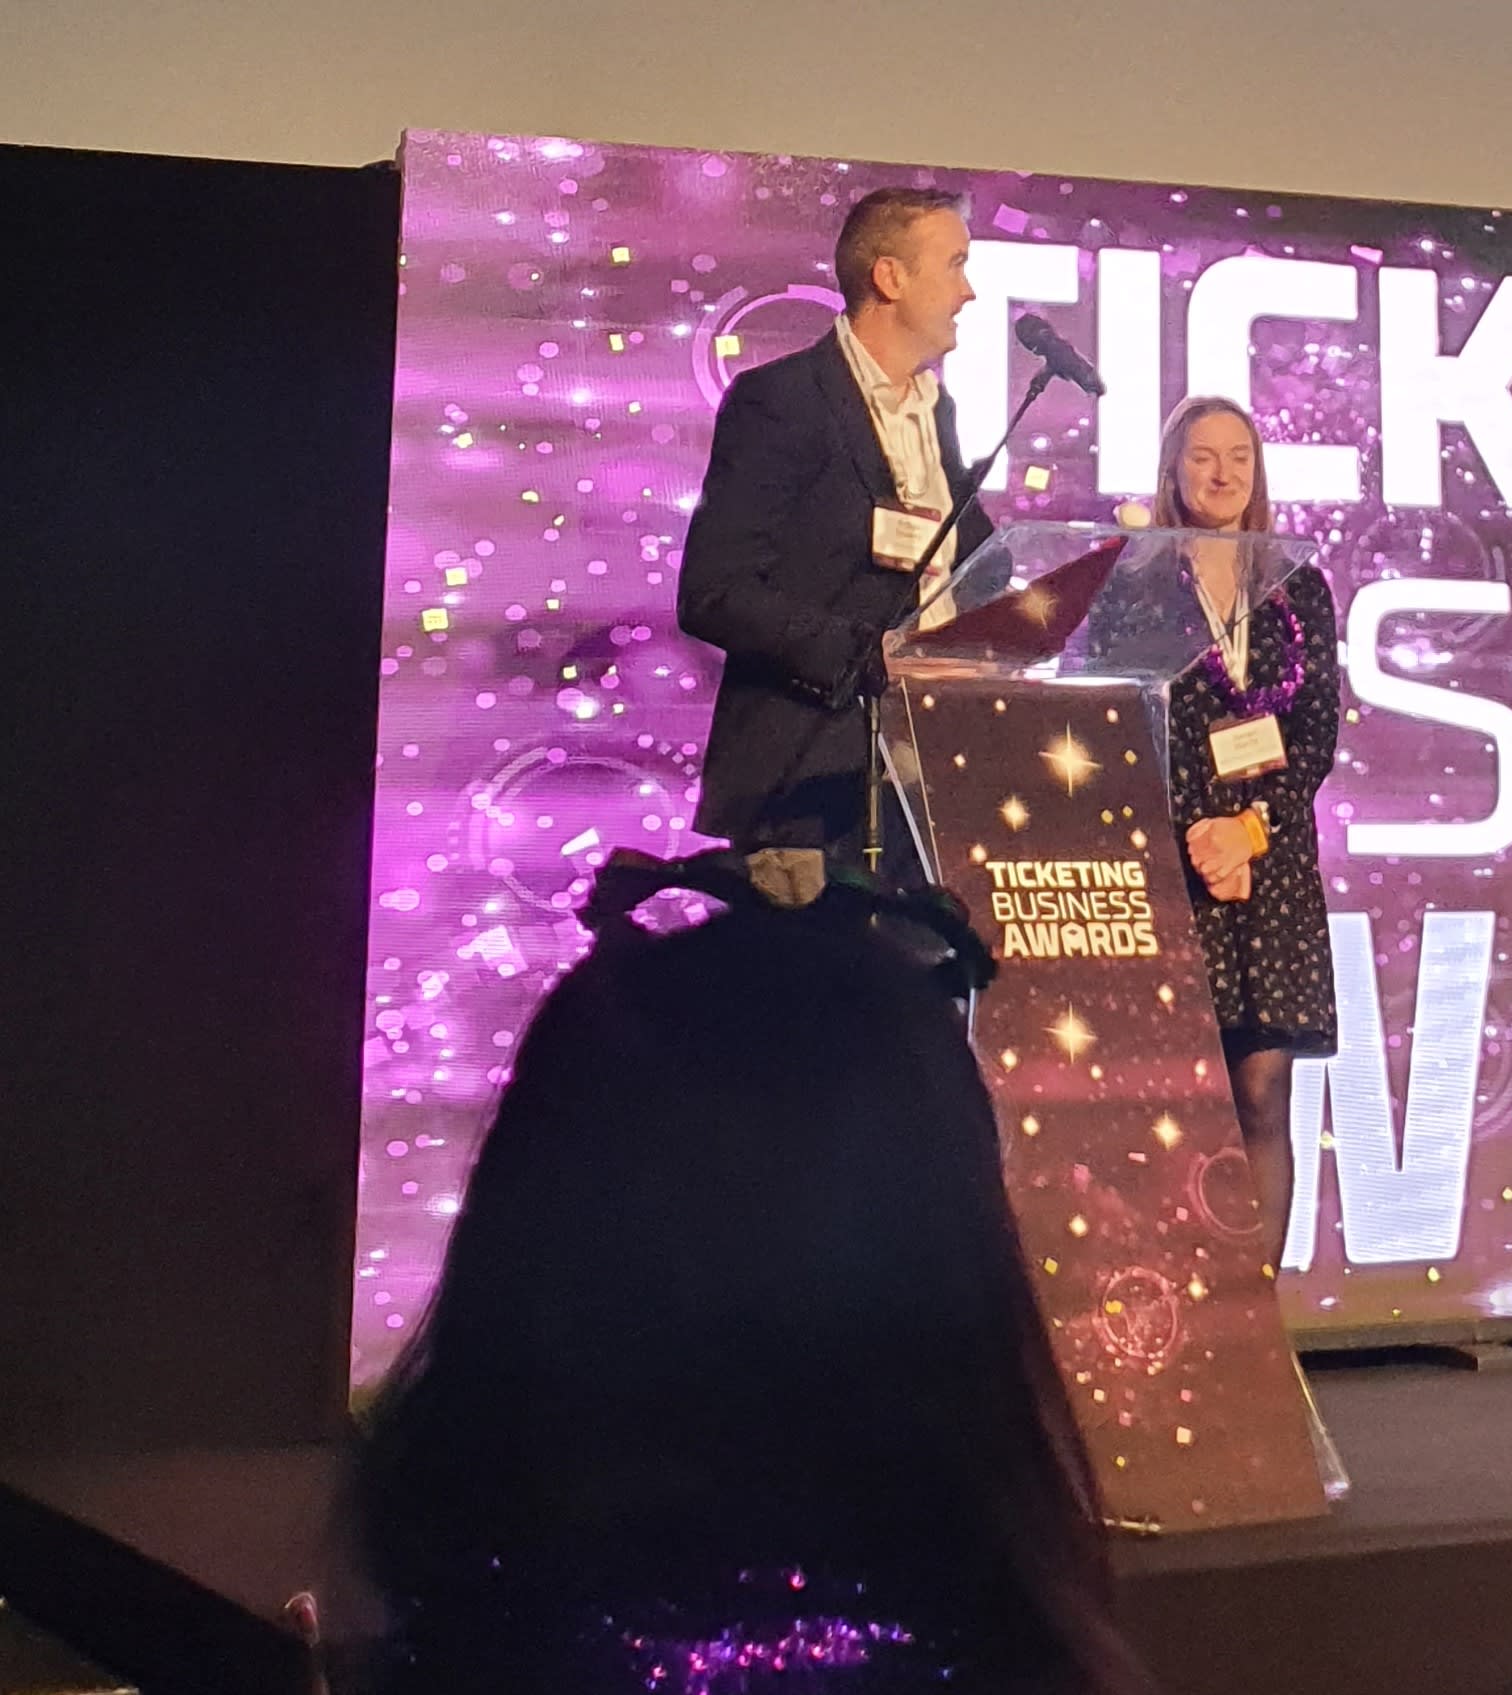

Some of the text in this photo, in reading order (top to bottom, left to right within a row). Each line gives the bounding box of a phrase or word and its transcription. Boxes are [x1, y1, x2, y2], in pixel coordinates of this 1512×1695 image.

[985, 861, 1145, 888] TICKETING
[991, 891, 1151, 921] BUSINESS
[1004, 921, 1160, 957] AWARDS
